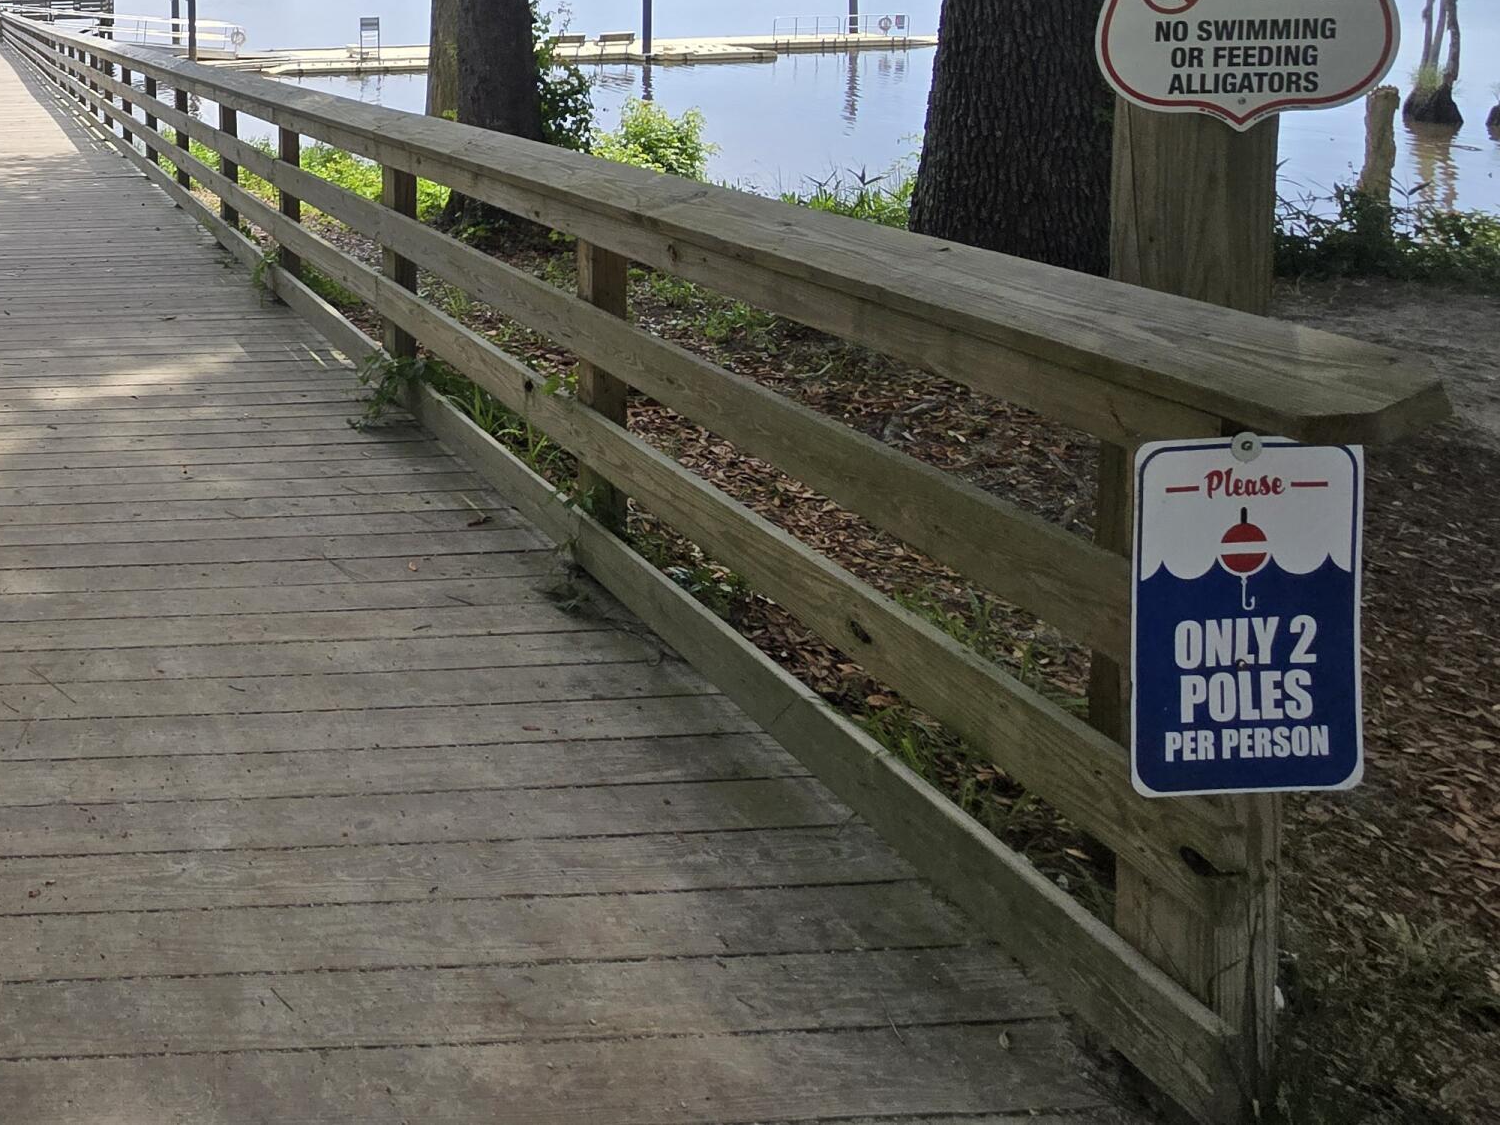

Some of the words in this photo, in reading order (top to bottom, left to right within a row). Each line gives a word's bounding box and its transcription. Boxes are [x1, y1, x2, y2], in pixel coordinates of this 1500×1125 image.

[1155, 20, 1189, 42] NO
[1197, 18, 1337, 41] SWIMMING
[1171, 47, 1204, 68] OR
[1212, 45, 1318, 67] FEEDING
[1168, 71, 1319, 94] ALLIGATORS
[1204, 467, 1286, 499] Please
[1174, 616, 1280, 669] ONLY
[1289, 614, 1318, 664] 2
[1180, 669, 1314, 724] POLES
[1164, 730, 1216, 762] PER
[1221, 725, 1330, 760] PERSON
